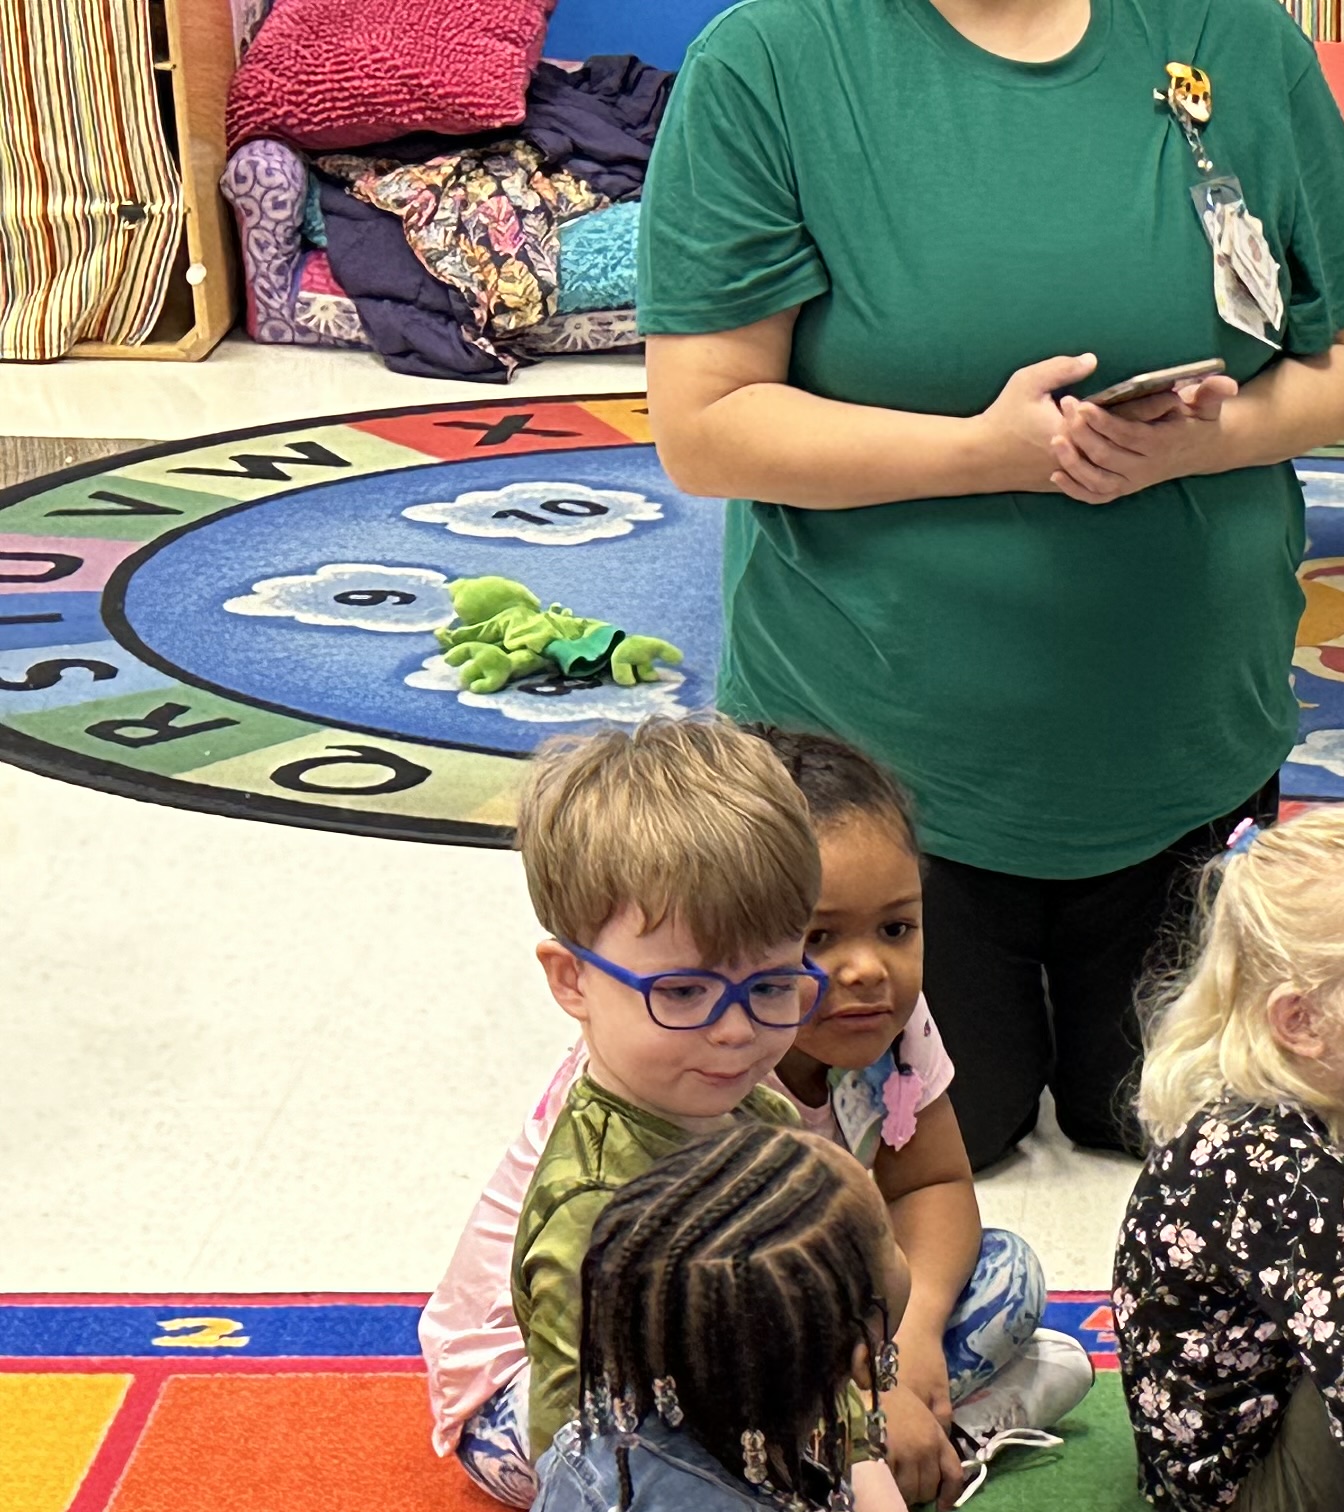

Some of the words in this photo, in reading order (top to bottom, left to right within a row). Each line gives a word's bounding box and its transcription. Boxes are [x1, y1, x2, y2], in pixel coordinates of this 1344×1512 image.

[433, 413, 581, 447] X
[44, 490, 185, 518] V
[491, 498, 609, 526] 10
[84, 702, 241, 749] R
[269, 744, 432, 796] Q
[152, 1316, 251, 1348] 2
